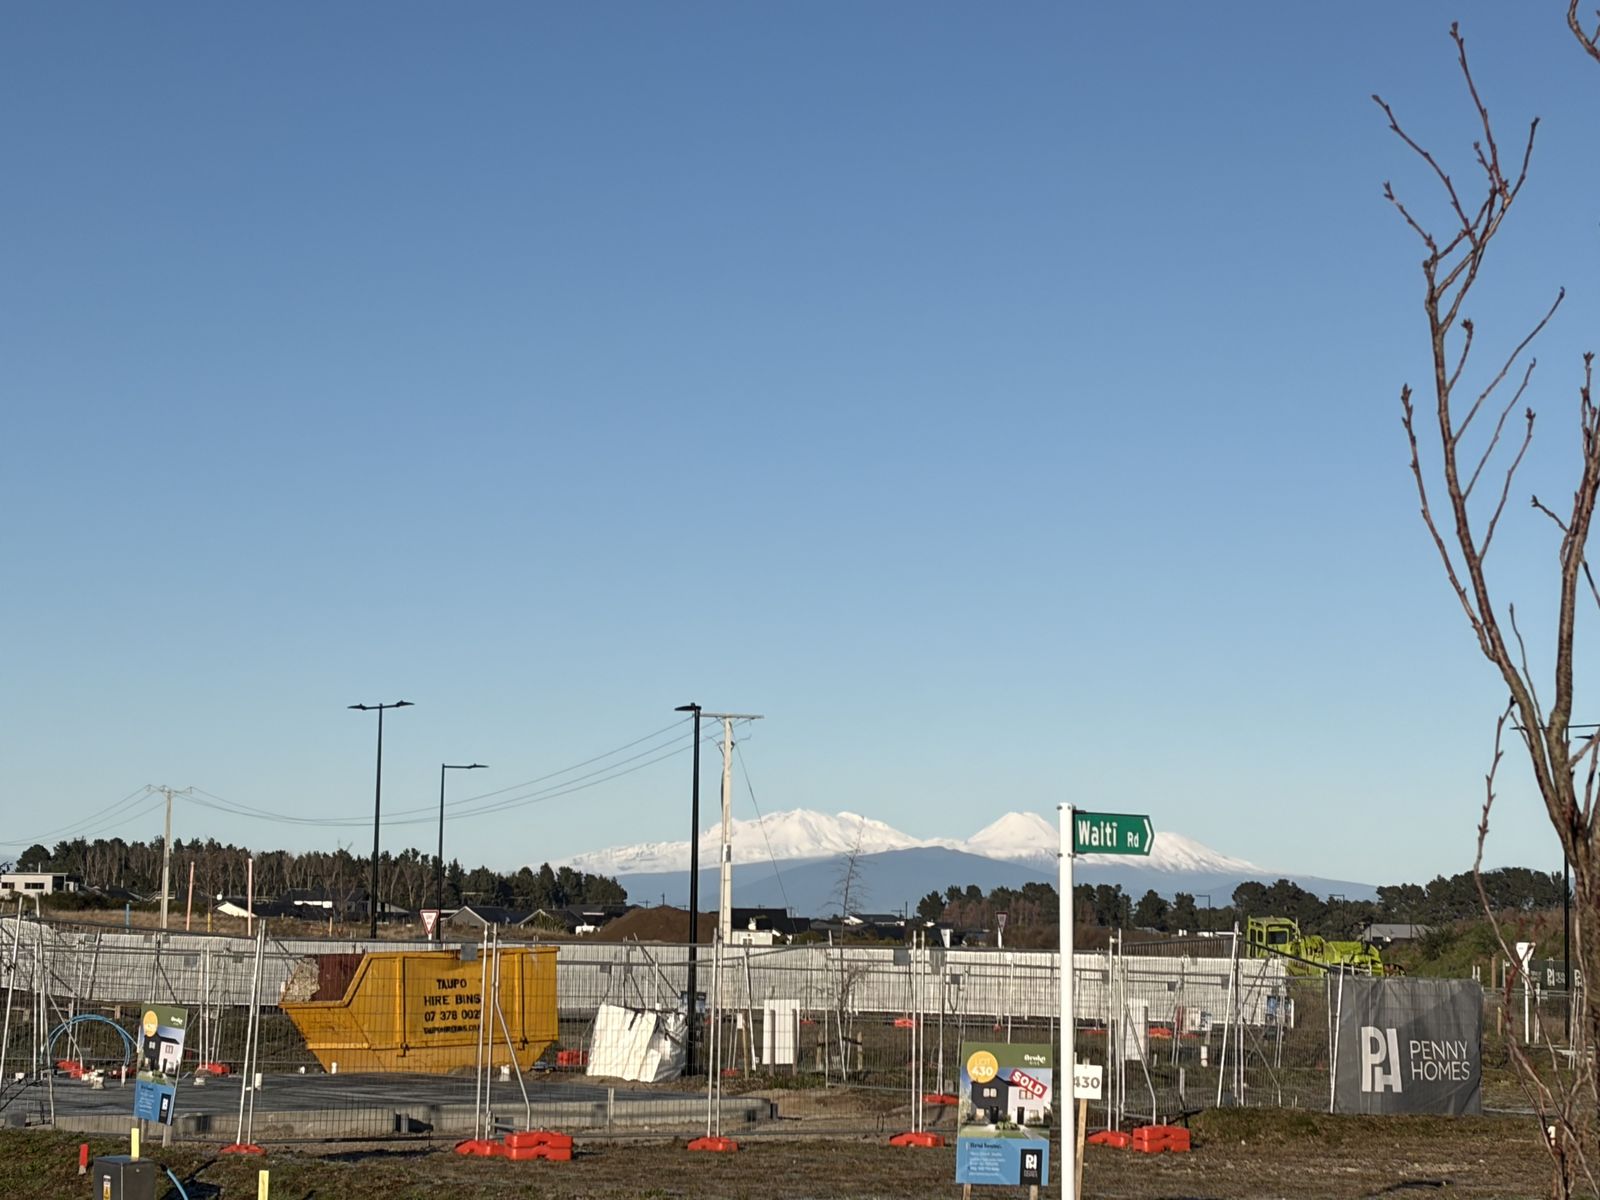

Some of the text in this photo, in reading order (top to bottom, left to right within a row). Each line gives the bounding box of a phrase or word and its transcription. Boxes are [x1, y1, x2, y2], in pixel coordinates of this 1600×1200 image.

[1127, 831, 1139, 848] Rd
[436, 979, 467, 989] TAUPO
[424, 994, 481, 1006] HIRE BINS
[424, 1009, 482, 1022] 07 378 002
[1409, 1040, 1468, 1061] PENNY
[971, 1065, 993, 1076] 430
[1411, 1061, 1471, 1081] HOMES
[1012, 1071, 1043, 1095] SOLD
